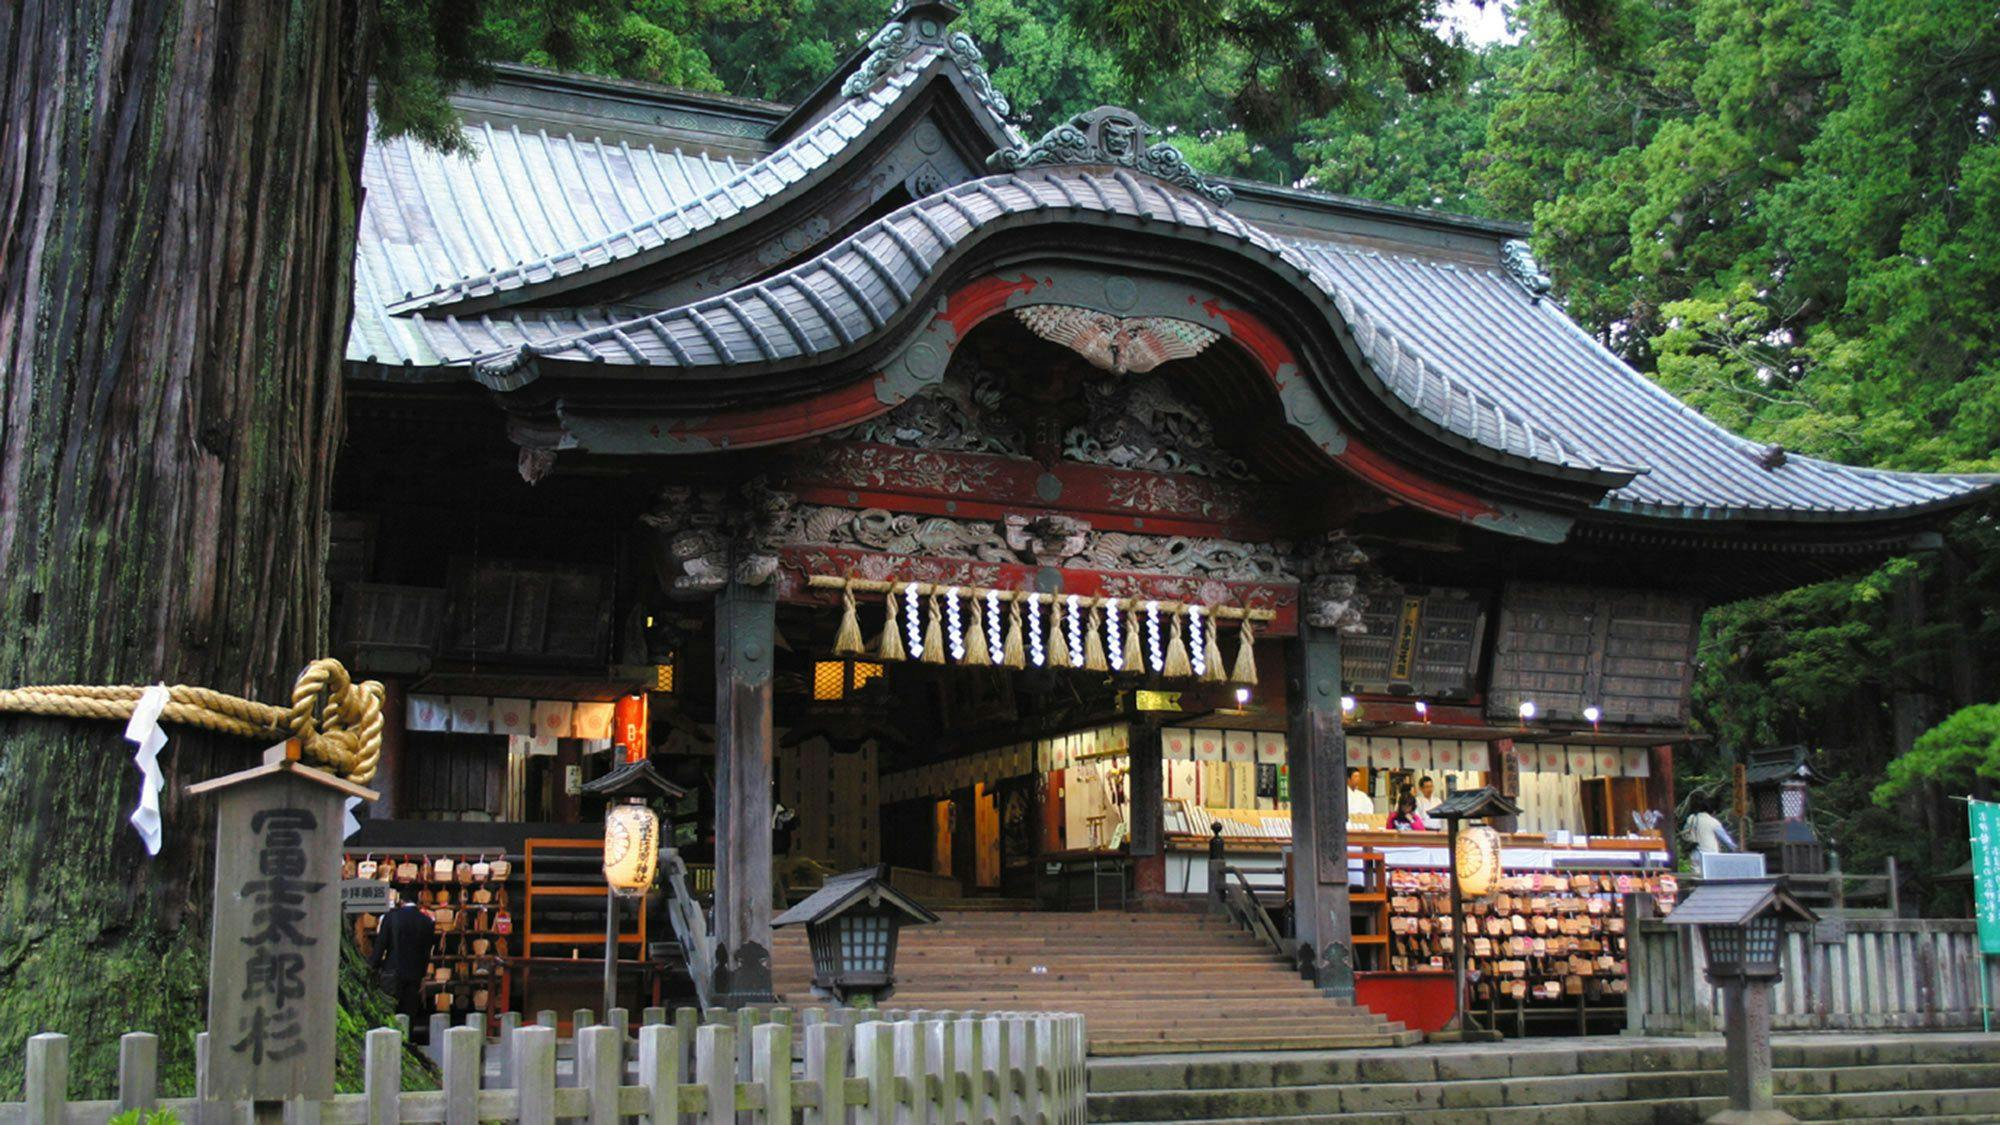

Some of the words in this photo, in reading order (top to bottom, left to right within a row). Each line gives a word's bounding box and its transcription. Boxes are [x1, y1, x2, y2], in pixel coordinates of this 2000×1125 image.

[231, 808, 327, 1066] 冨士太郎杉
